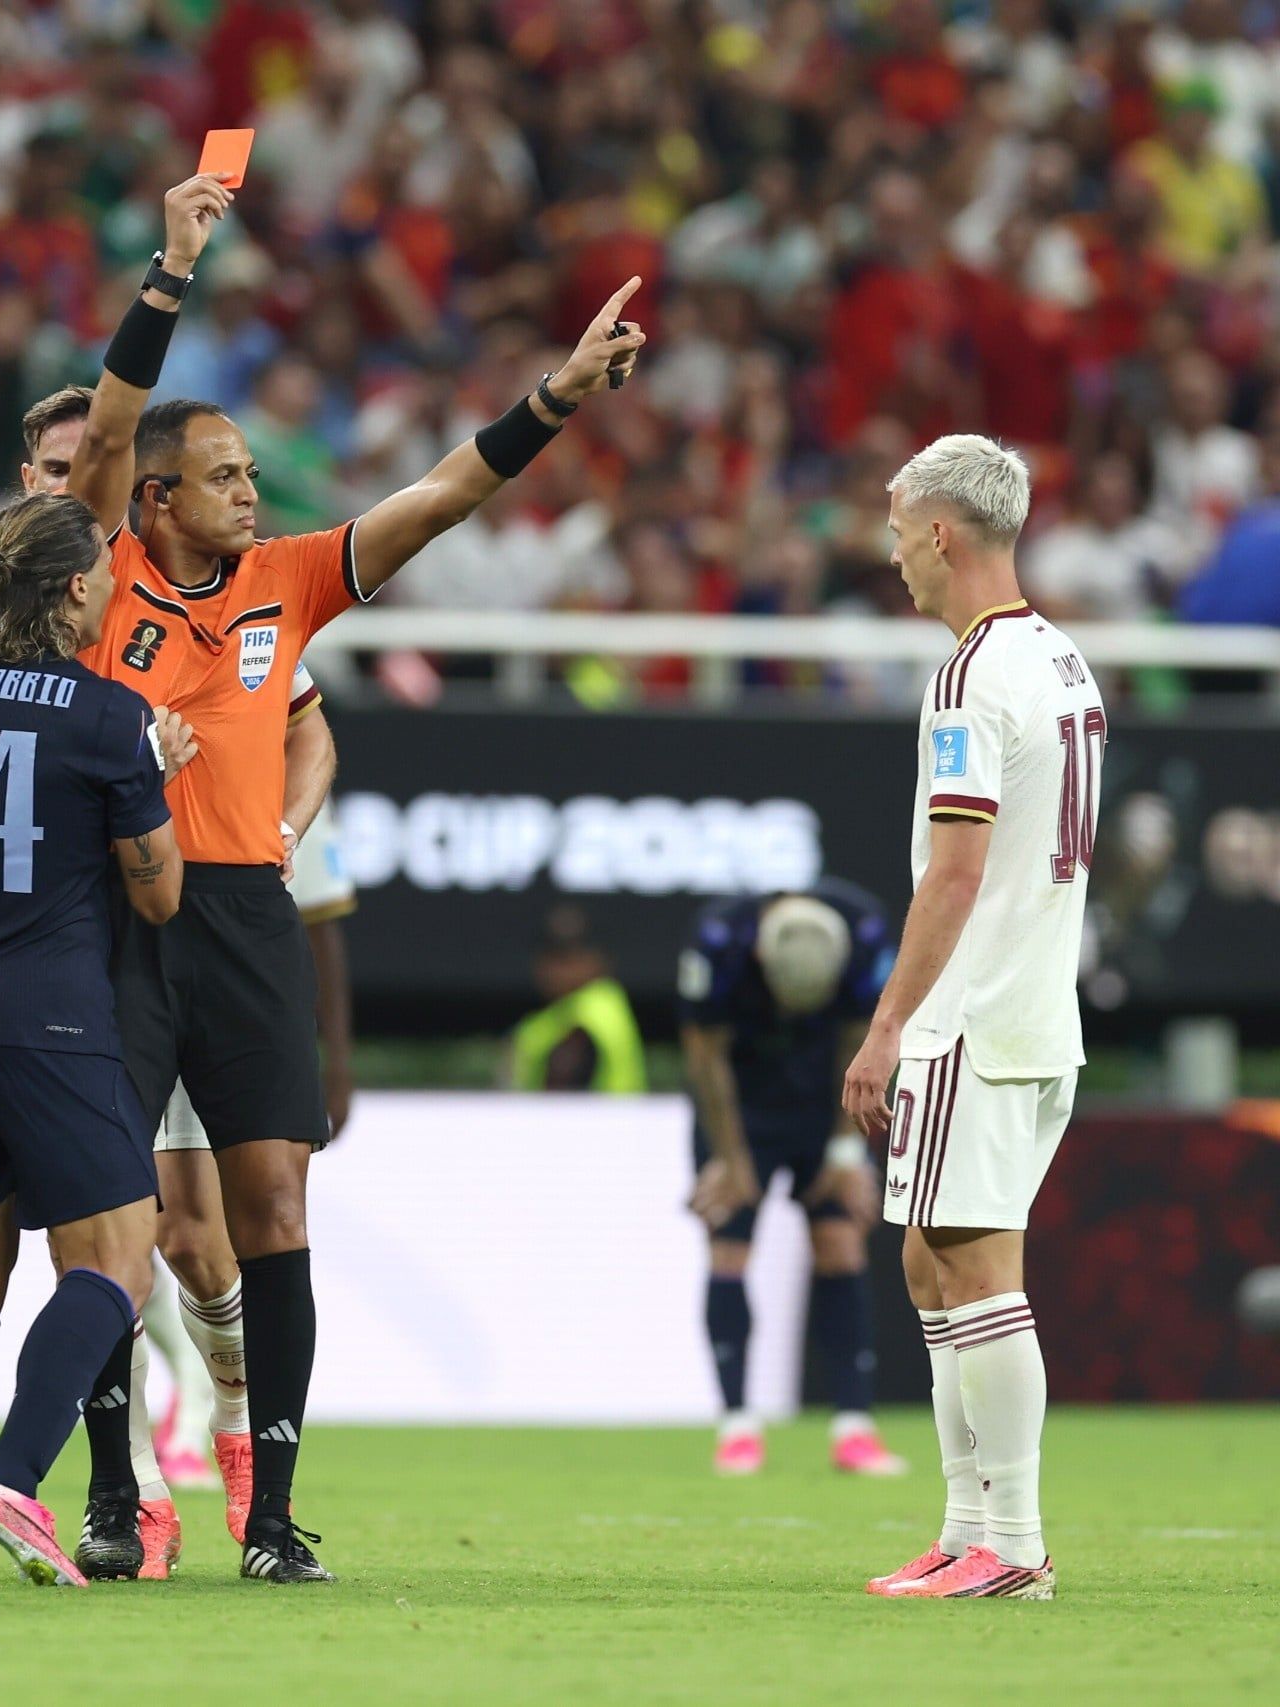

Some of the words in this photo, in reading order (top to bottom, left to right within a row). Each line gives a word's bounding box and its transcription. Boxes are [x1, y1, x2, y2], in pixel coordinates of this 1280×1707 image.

[242, 656, 272, 667] REFEREE
[244, 630, 274, 648] FIFA
[1050, 706, 1108, 884] 10
[407, 795, 550, 889] CUP
[552, 796, 821, 894] 2026
